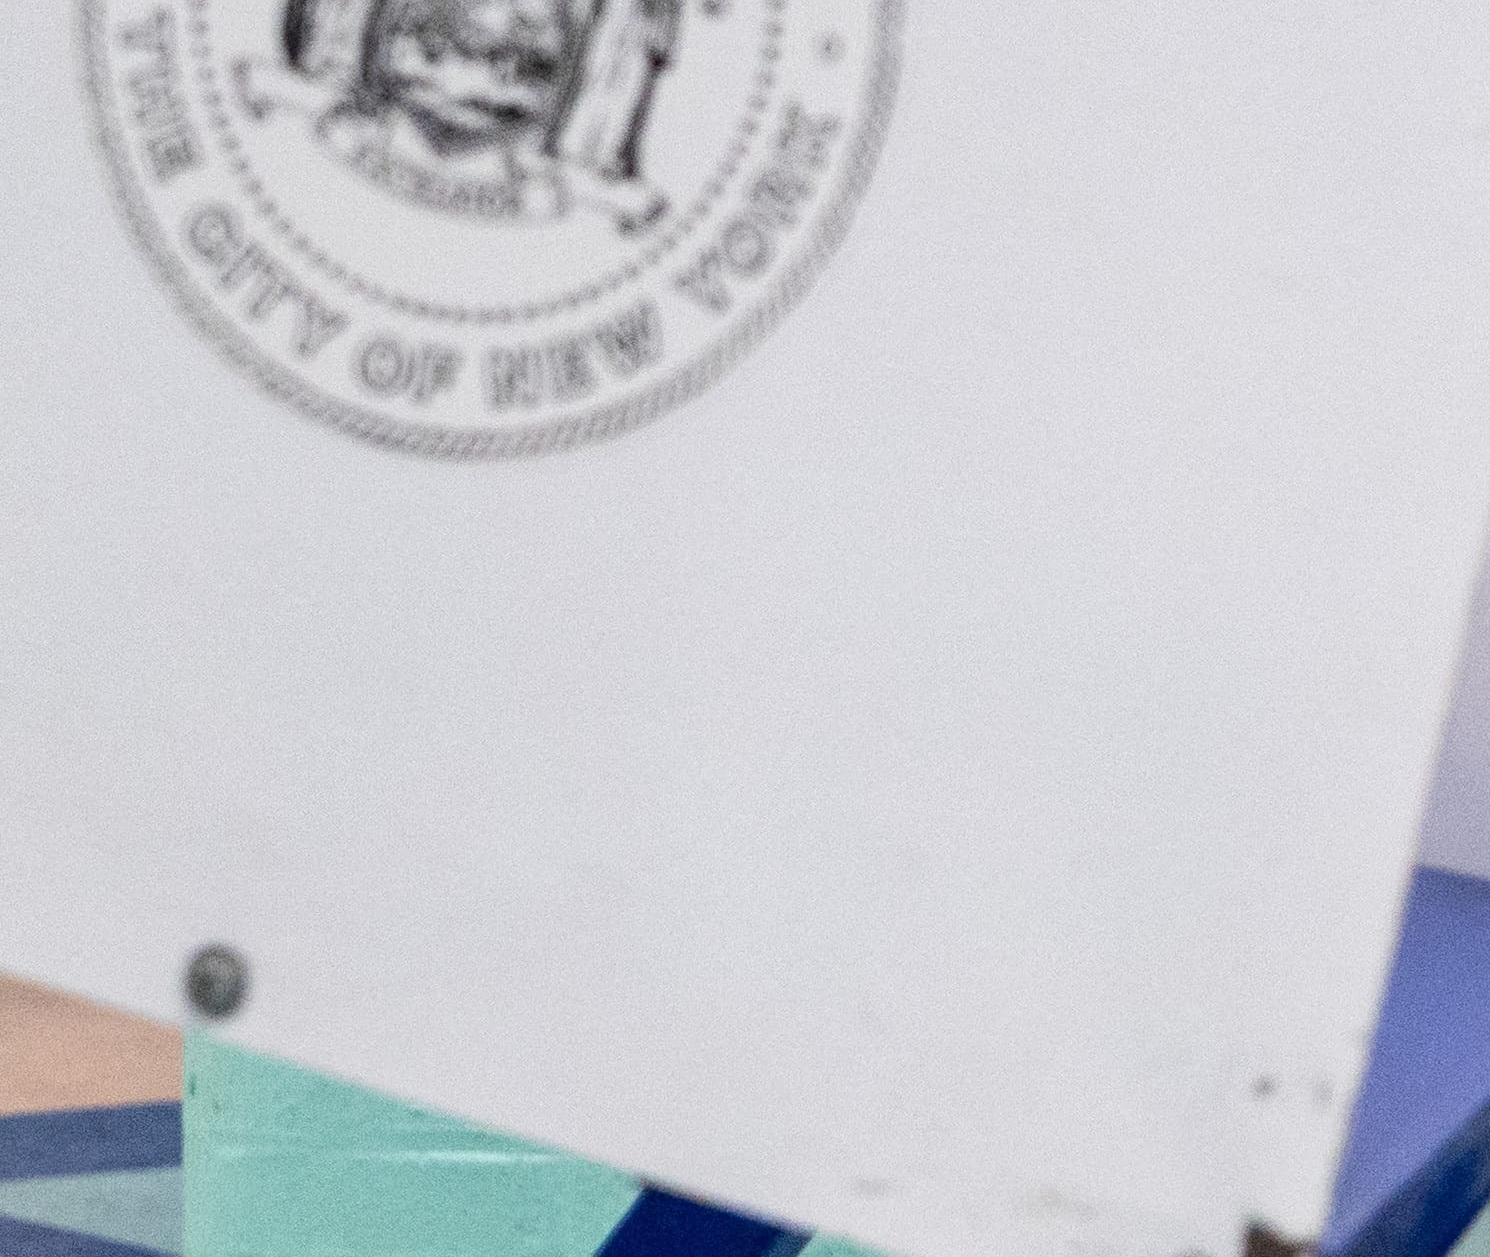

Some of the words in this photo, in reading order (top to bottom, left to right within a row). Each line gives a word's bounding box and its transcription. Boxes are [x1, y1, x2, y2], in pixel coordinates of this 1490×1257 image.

[121, 3, 202, 184] THE
[184, 201, 350, 357] CITY
[357, 336, 461, 406] OF
[485, 301, 666, 413] NEW
[675, 103, 840, 316] YORK
